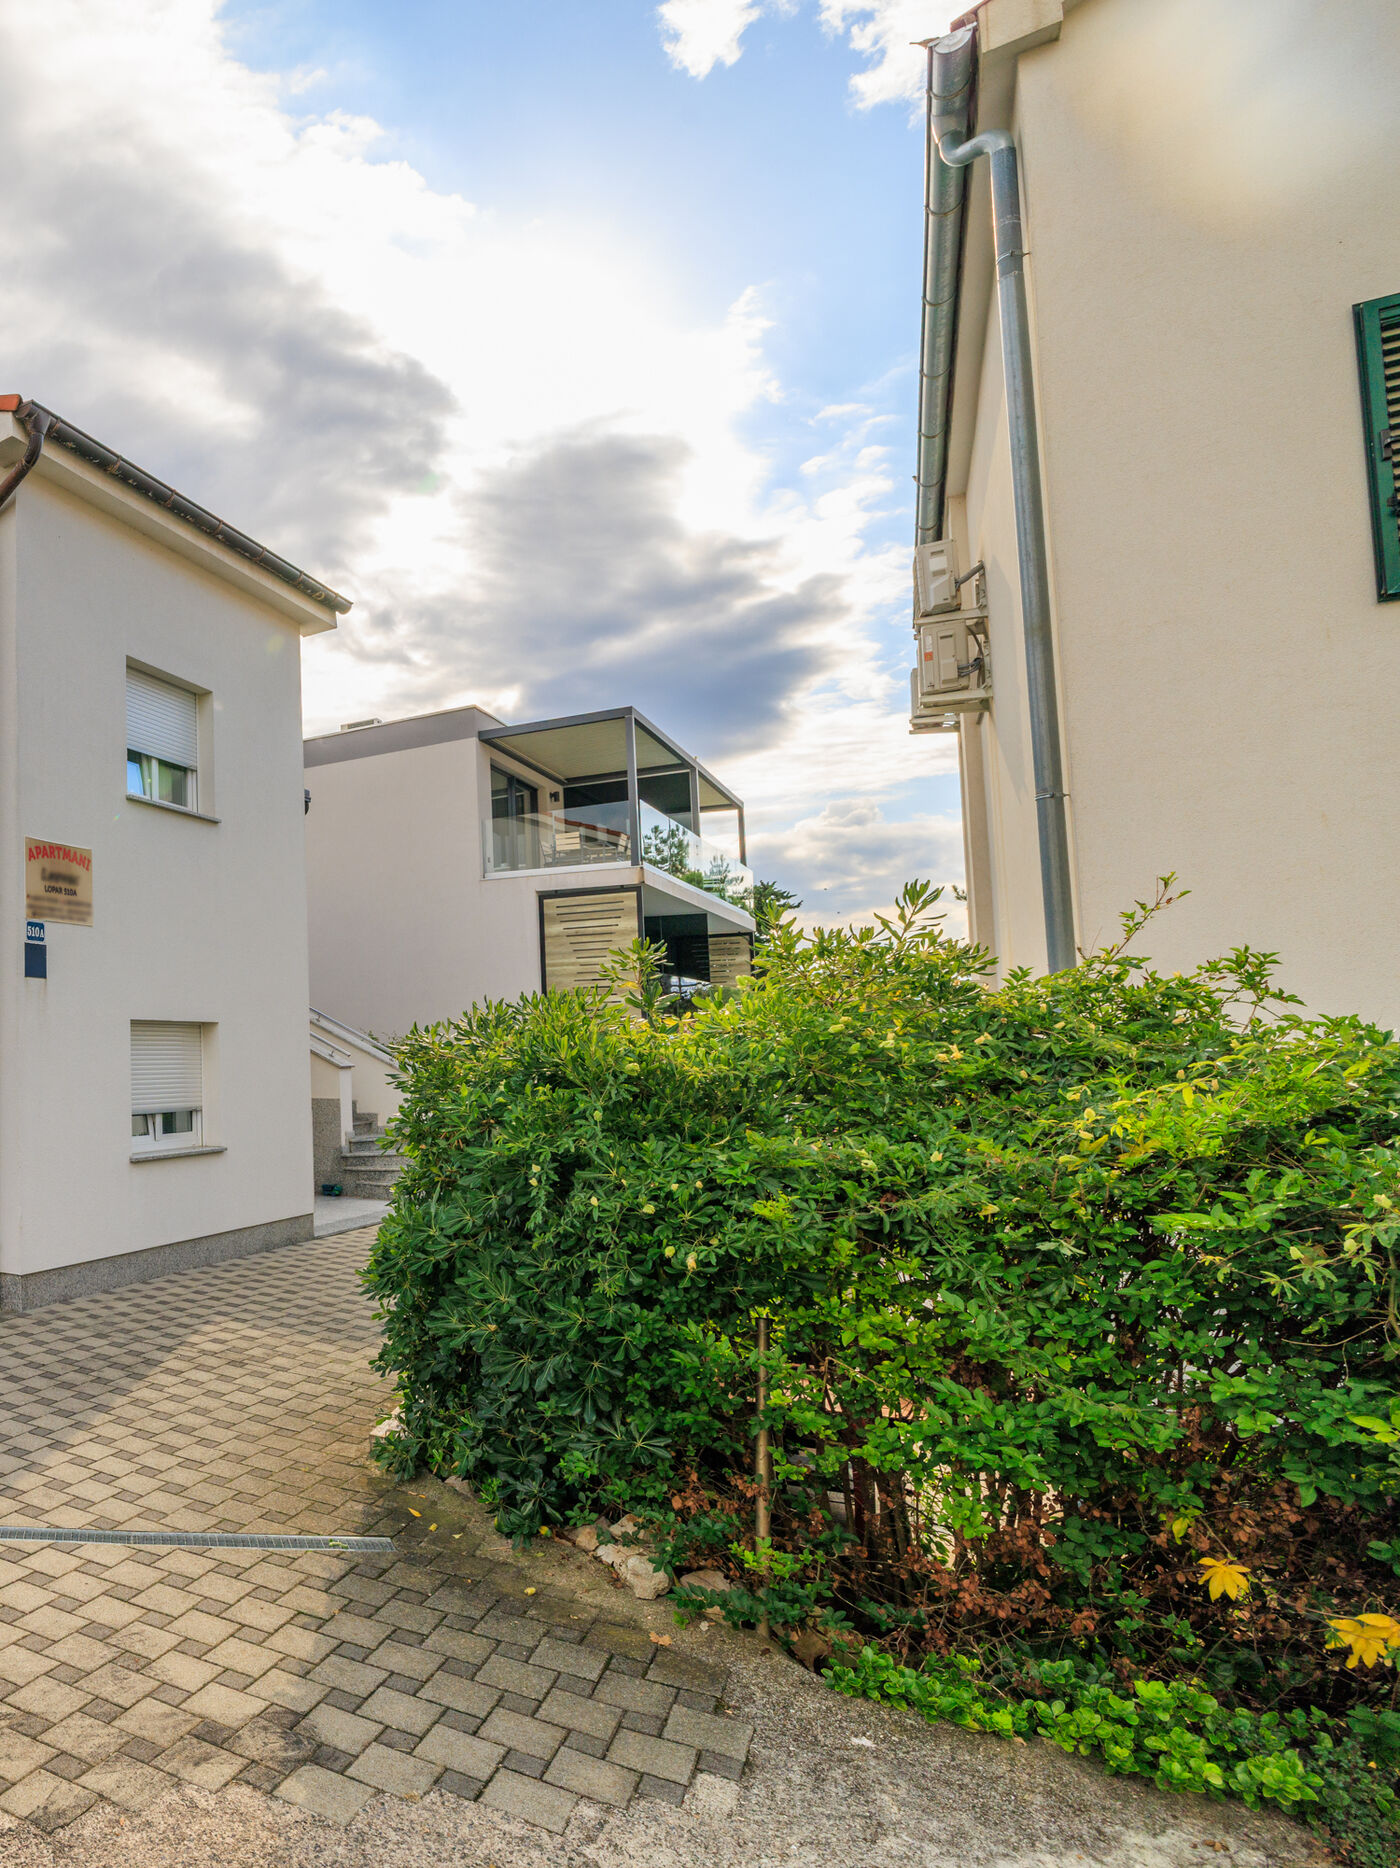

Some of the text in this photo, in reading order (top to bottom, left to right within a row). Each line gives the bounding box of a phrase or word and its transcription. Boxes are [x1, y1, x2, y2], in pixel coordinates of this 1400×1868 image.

[28, 845, 91, 872] APARTMANI
[44, 885, 77, 896] LOPAR 510A
[27, 926, 44, 938] 510A
